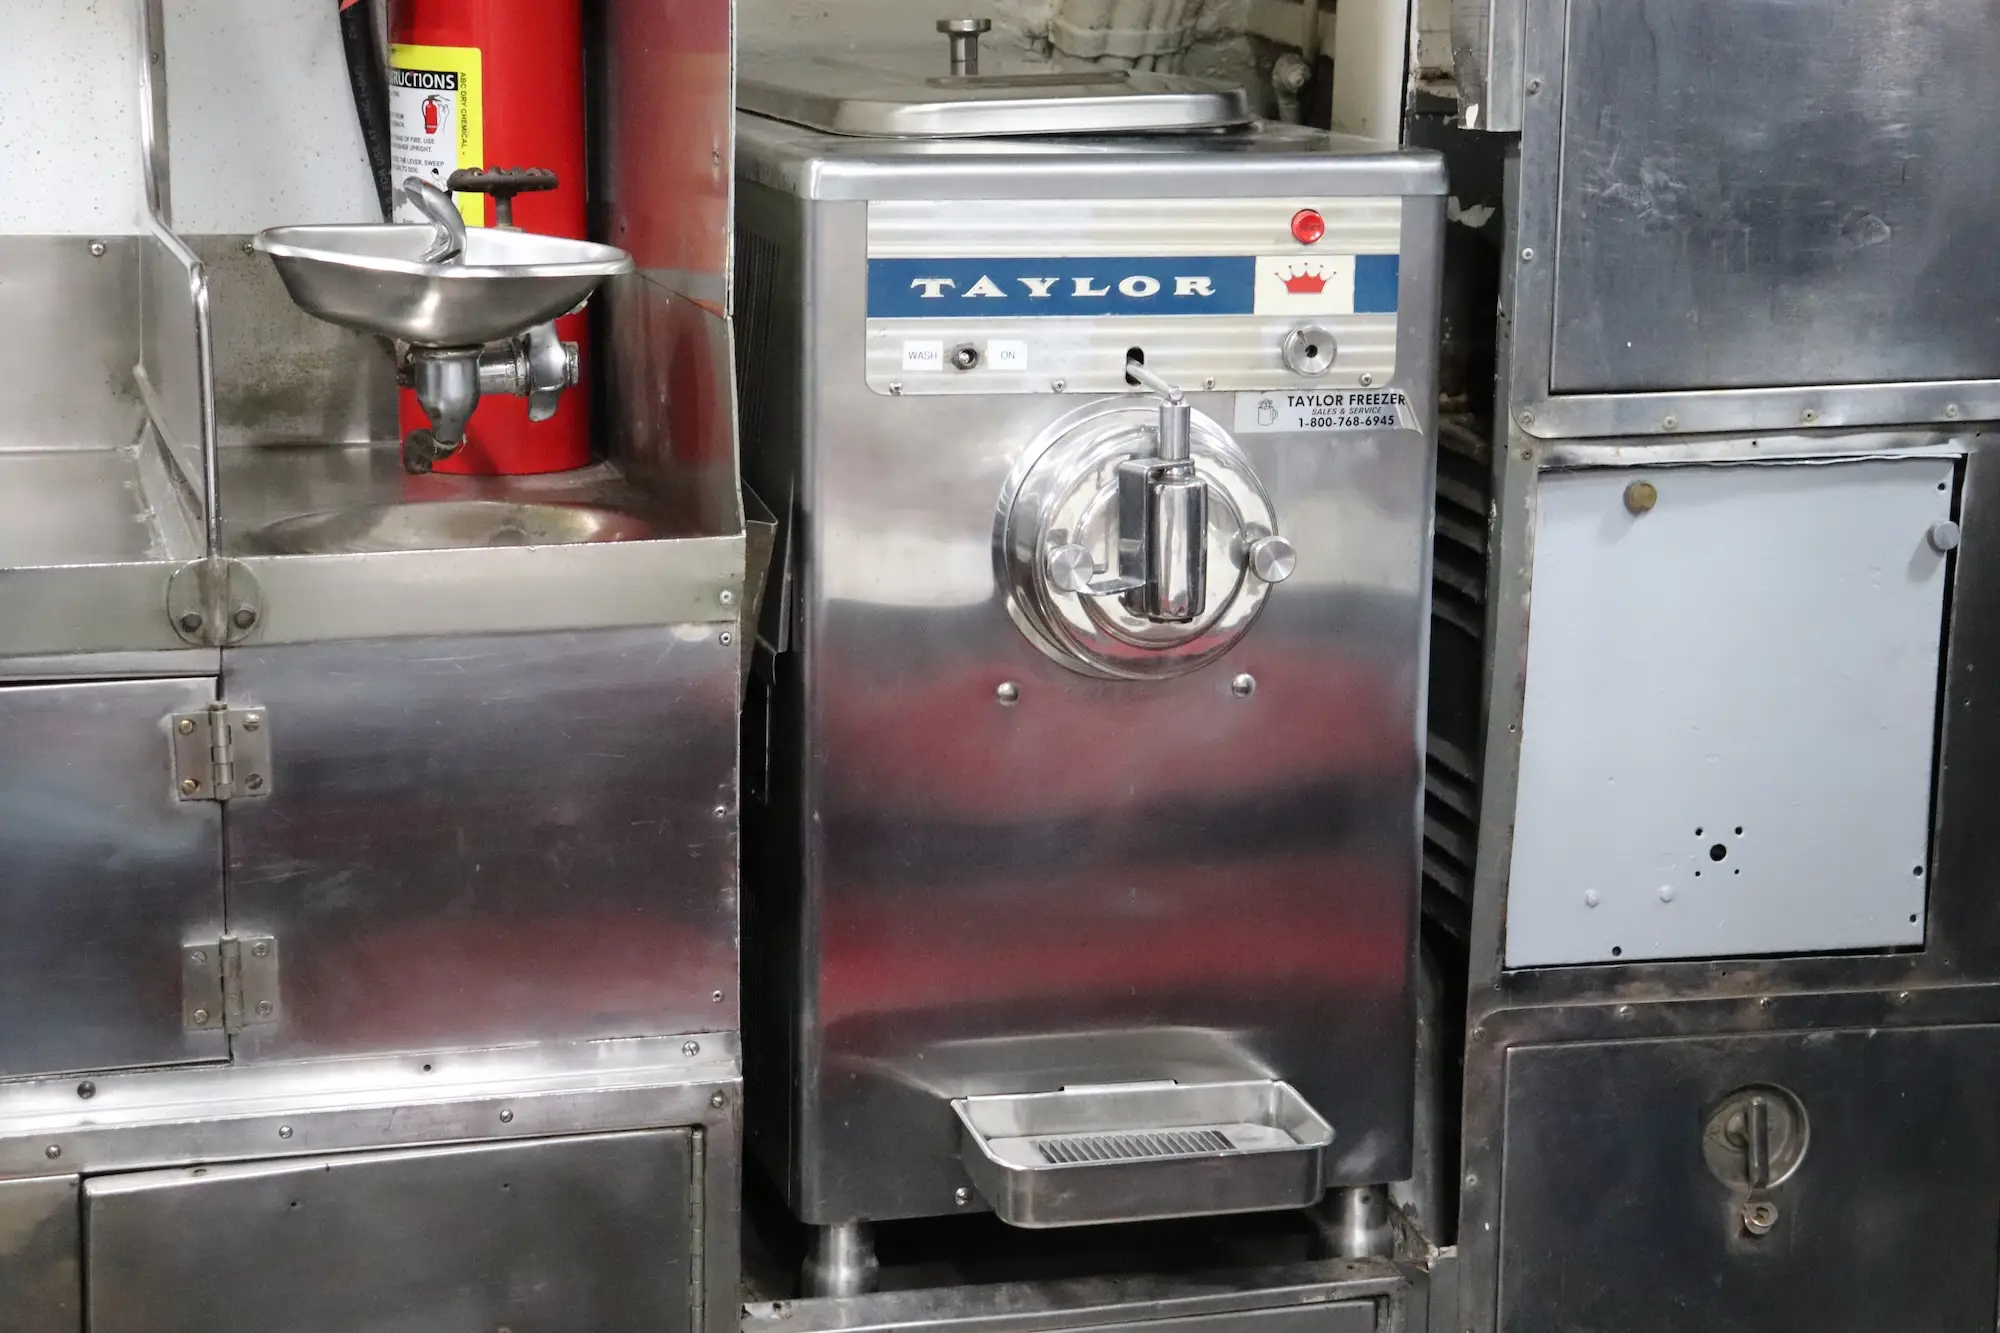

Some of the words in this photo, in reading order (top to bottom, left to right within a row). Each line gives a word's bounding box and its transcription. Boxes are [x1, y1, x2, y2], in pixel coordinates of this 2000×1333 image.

[460, 91, 468, 107] DRY
[460, 109, 468, 148] CHEMICAL
[424, 137, 435, 145] USE
[424, 159, 445, 167] SWEEP
[910, 275, 1216, 298] TAYLOR
[908, 350, 938, 361] WASH
[1000, 350, 1015, 360] ON
[1287, 395, 1344, 407] TAYLOR
[1349, 393, 1406, 406] FREEZER
[1311, 408, 1337, 416] SALES
[1339, 407, 1346, 415] &
[1349, 406, 1383, 415] SERVICE
[1298, 415, 1395, 428] 1-800-768-6945
